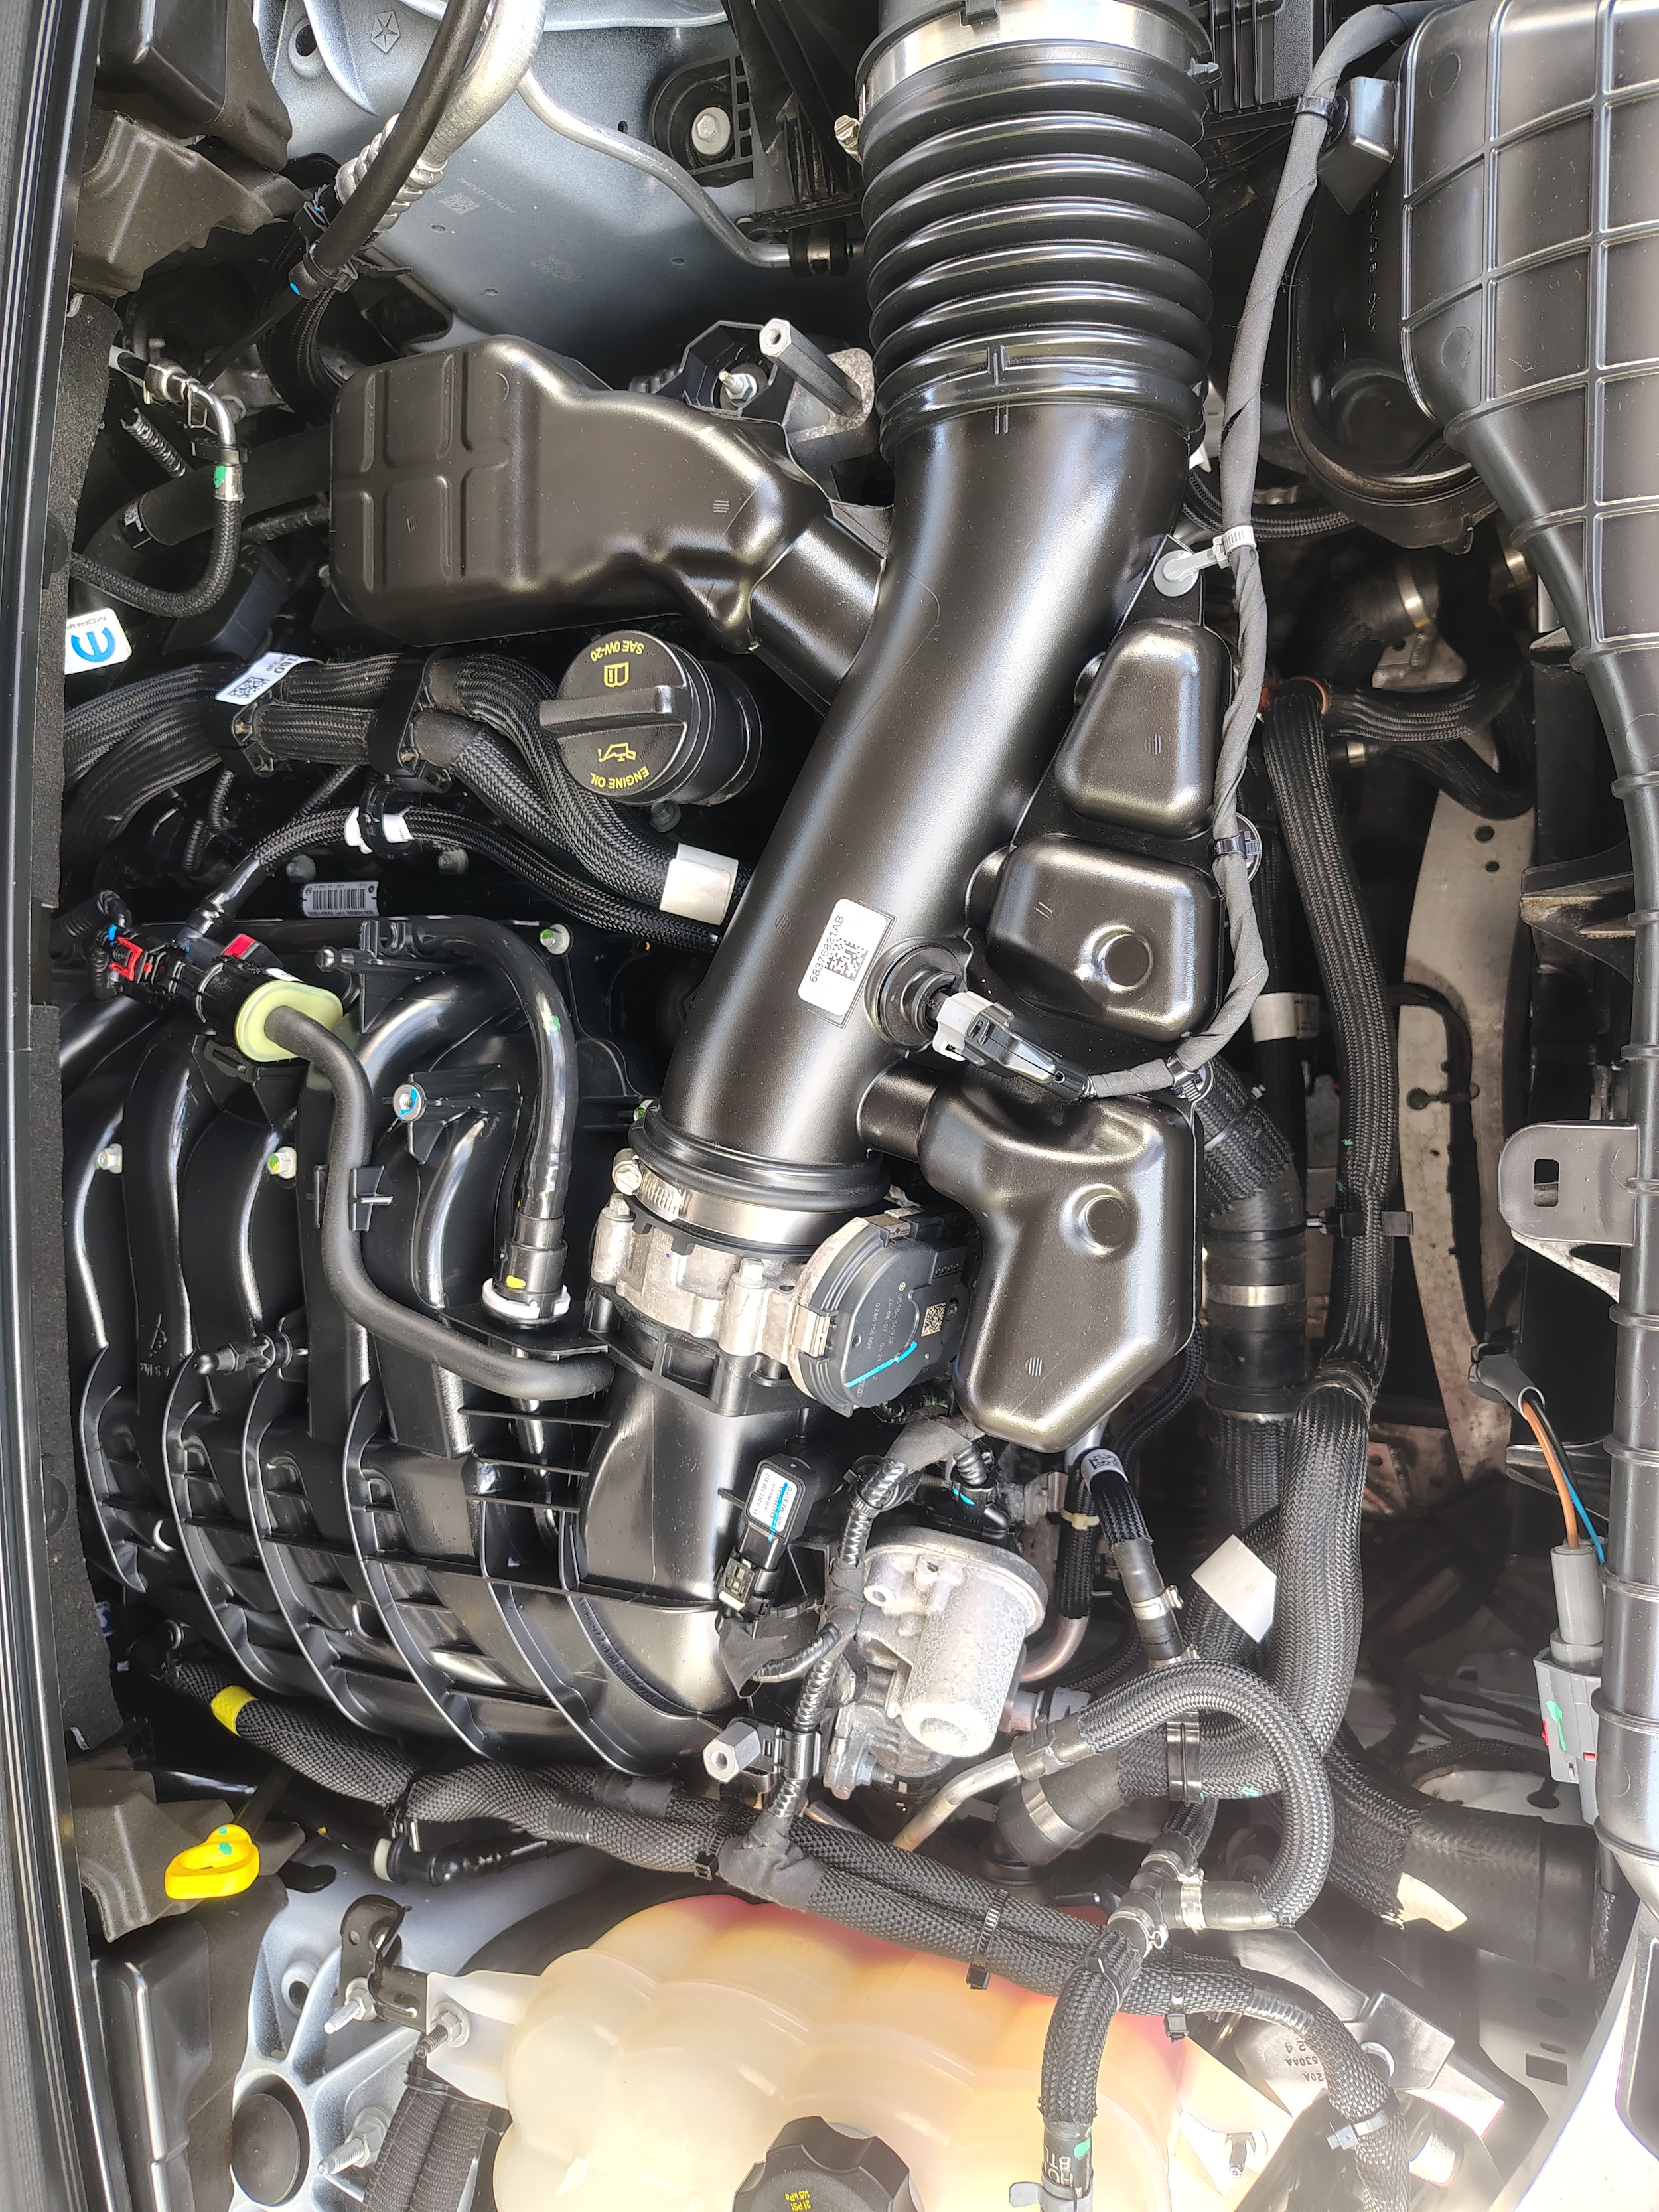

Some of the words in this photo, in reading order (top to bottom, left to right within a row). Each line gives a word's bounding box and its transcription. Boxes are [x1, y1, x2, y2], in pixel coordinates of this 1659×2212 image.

[590, 640, 620, 662] 0W-20
[622, 640, 644, 655] SAE
[589, 773, 607, 788] OIL
[609, 765, 650, 789] ENGINE
[809, 915, 844, 983] 68376821AB
[883, 1297, 894, 1333] 24-08-07
[888, 1293, 903, 1345] 05184349AF
[780, 1487, 792, 1512] MEXICO
[1285, 2056, 1318, 2067] 530AA
[784, 2191, 799, 2201] kPa
[798, 2189, 810, 2200] 145
[790, 2201, 804, 2212] PSI
[802, 2199, 811, 2209] 21
